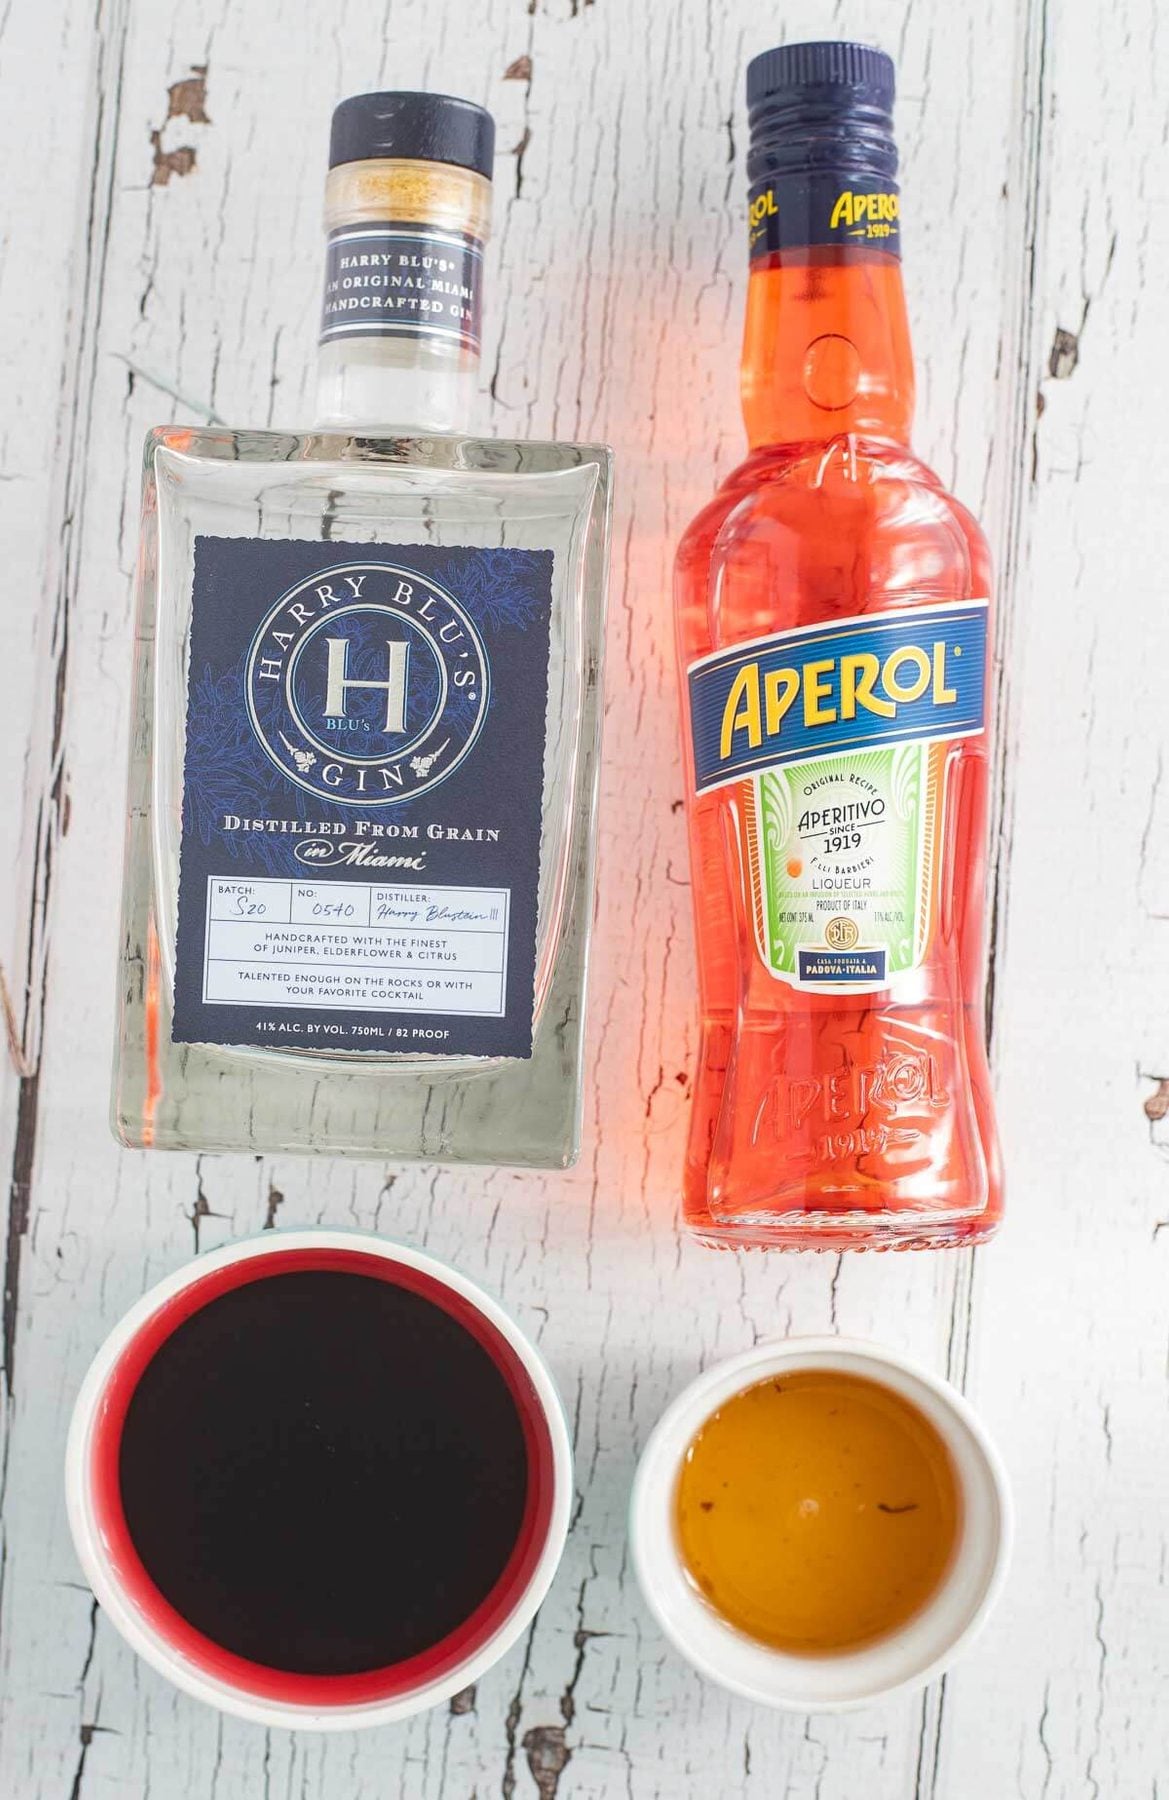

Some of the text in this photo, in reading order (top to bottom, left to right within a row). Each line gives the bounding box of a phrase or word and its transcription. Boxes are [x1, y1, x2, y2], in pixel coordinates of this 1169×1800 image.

[866, 224, 890, 239] 1919
[340, 254, 391, 269] HARRY
[342, 275, 425, 290] ORIGINAL
[325, 296, 443, 314] HANDCRAFTED
[259, 576, 367, 681] HARRY
[322, 637, 411, 733] H
[719, 640, 957, 760] APEROL
[321, 763, 404, 791] GIN
[803, 773, 879, 796] ORIGINAL RECIPE
[797, 798, 885, 832] APERITIVO
[829, 823, 856, 836] SINCE
[823, 833, 862, 854] 1919
[338, 841, 427, 870] Miami
[812, 878, 871, 890] LIQUEUR
[218, 886, 431, 903] BATCH: NO: DISTILLER:
[816, 899, 868, 911] PRODUCT OF ITALY
[265, 932, 448, 949] HANDCRAFTED WITH THE FINEST
[253, 943, 268, 953] OF
[323, 946, 402, 959] ELDERFLOWER
[406, 949, 413, 959] &
[418, 950, 457, 961] CITRUS
[238, 971, 473, 990] TALENTED ENOUGH ON THE ROCKS OR WITH
[285, 986, 424, 1000] YOUR FAVORITE COCKTAIL
[255, 1022, 276, 1032] 41%
[278, 1023, 304, 1033] ALC.
[307, 1024, 321, 1033] BY
[323, 1025, 348, 1035] VOL.
[351, 1026, 385, 1037] 750ML
[396, 1027, 409, 1038] 82
[412, 1028, 450, 1040] PROOF
